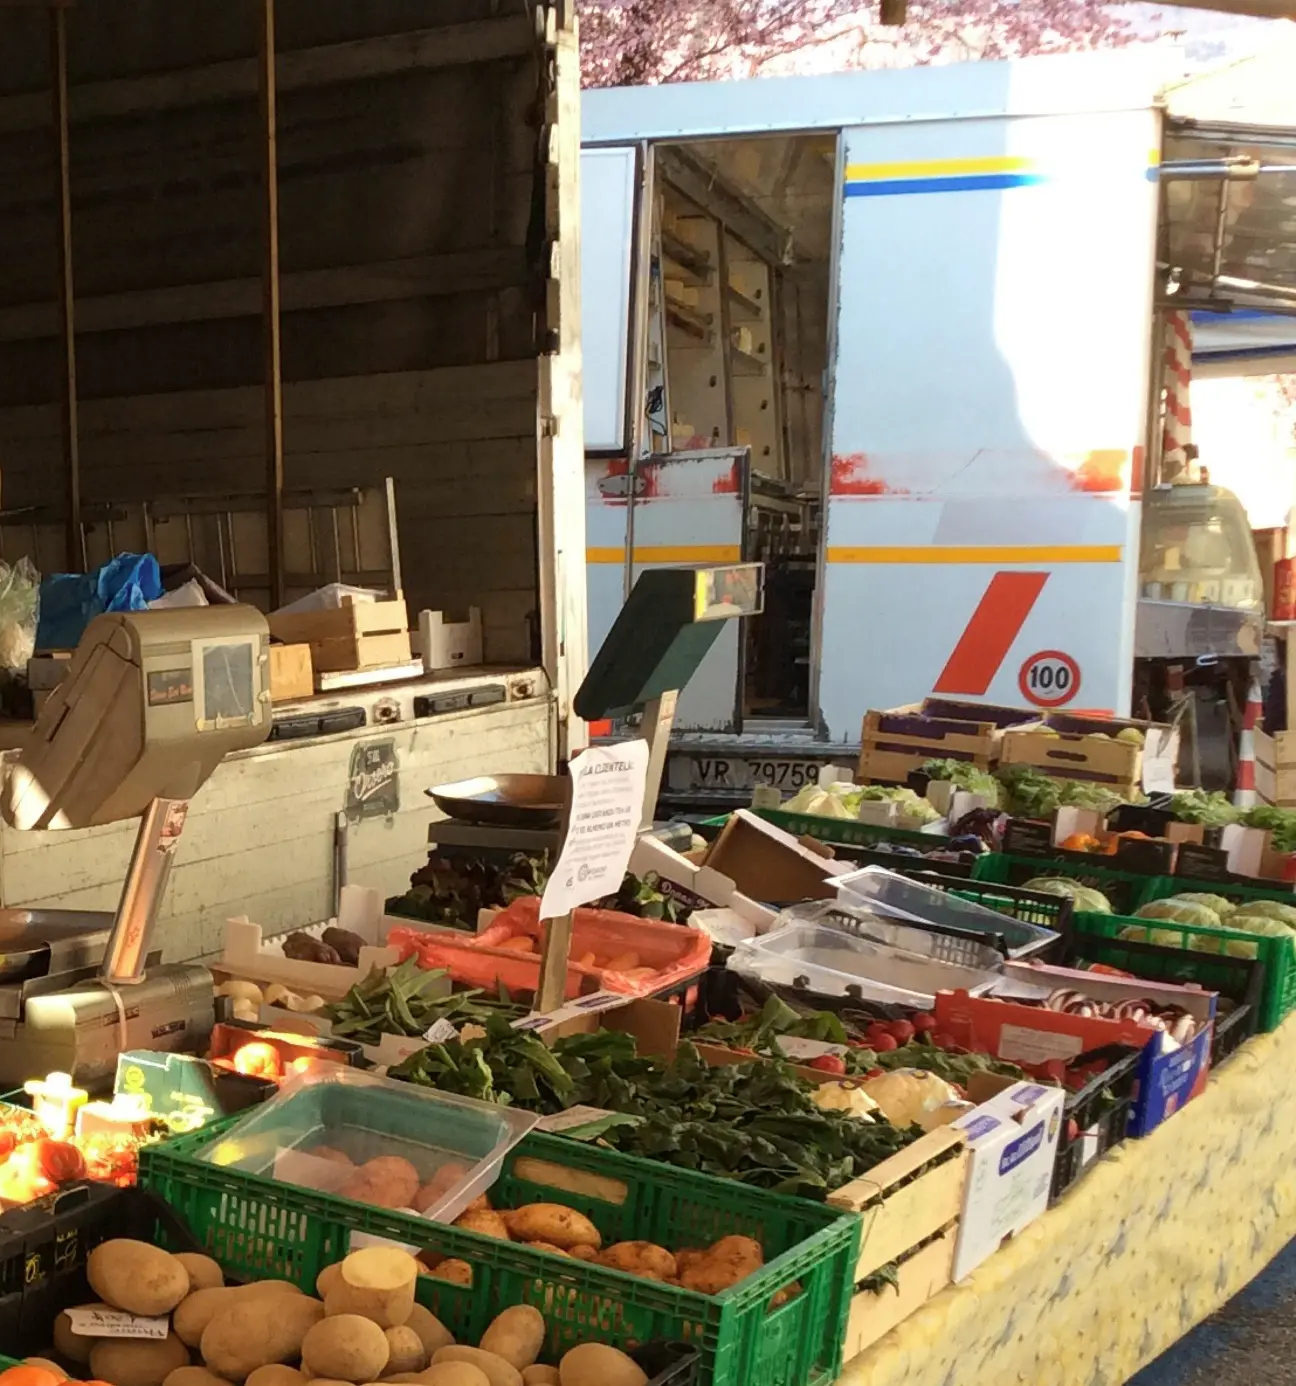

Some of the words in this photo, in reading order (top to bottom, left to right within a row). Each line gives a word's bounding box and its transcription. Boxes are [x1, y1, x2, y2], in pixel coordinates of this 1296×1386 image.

[1031, 665, 1070, 690] 100
[697, 760, 730, 783] VR
[748, 762, 820, 787] 79759
